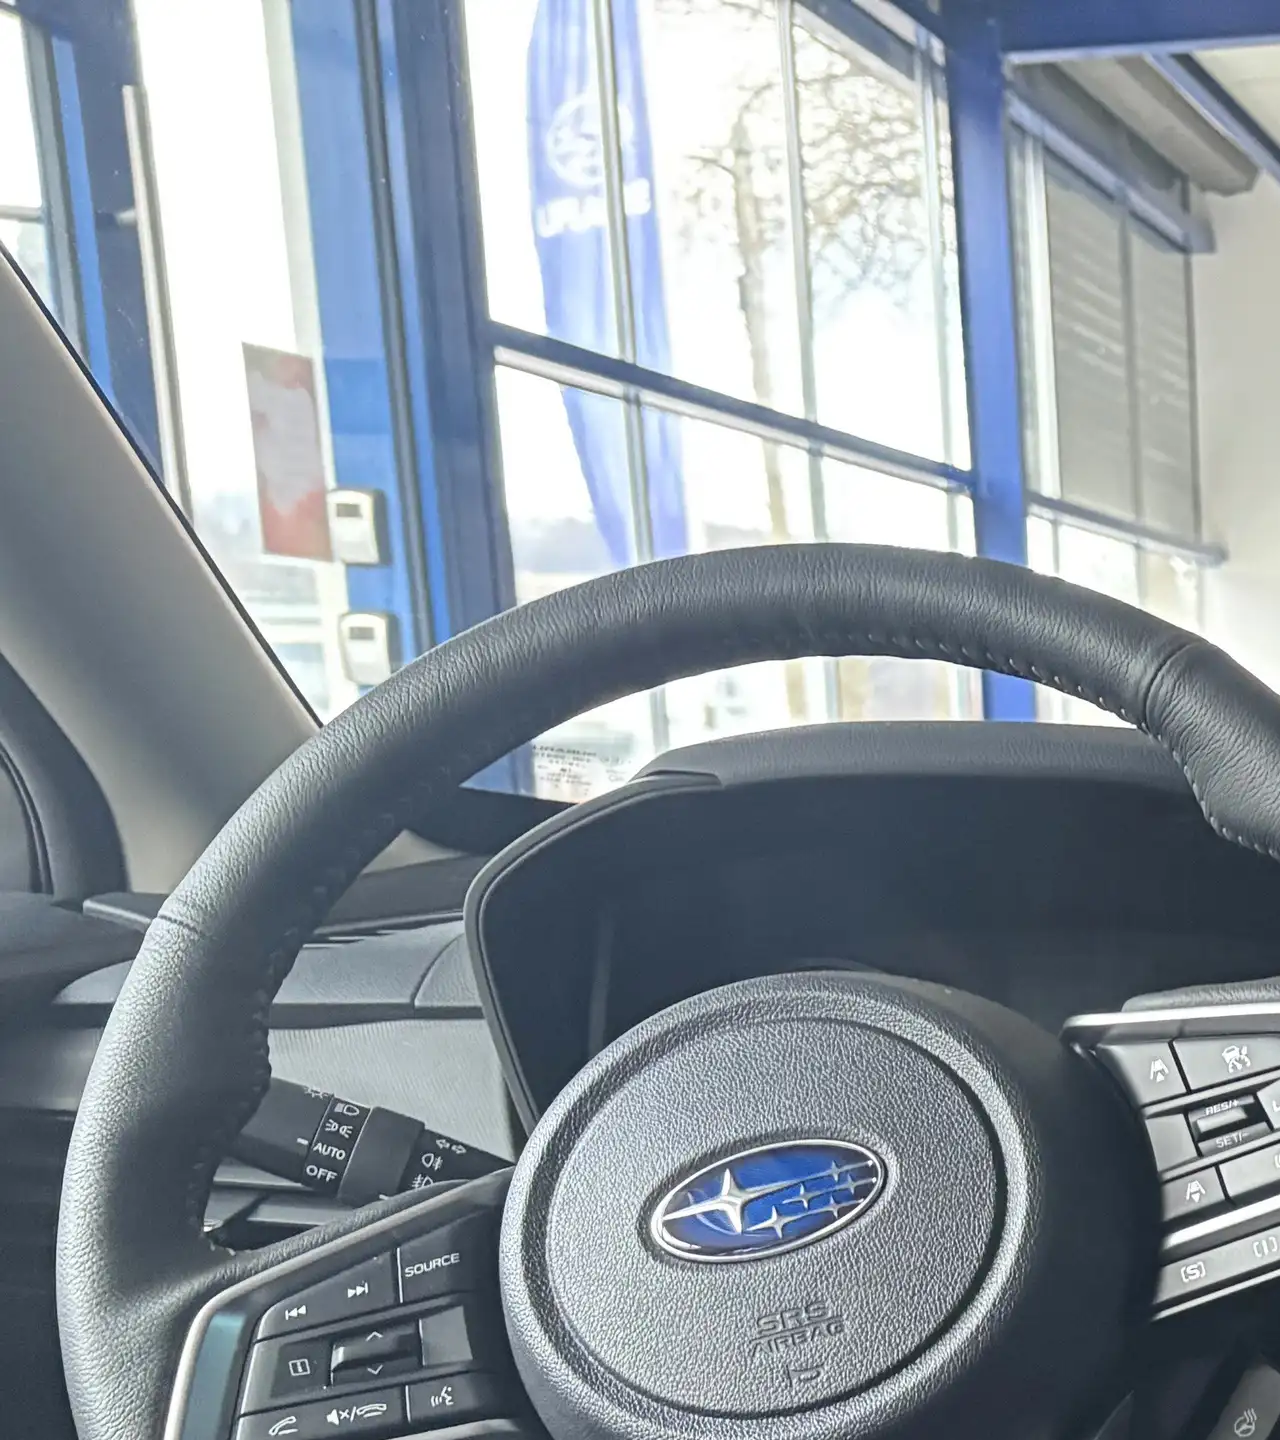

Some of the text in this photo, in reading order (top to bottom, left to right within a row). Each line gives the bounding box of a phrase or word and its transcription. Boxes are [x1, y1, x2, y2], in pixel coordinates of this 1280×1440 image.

[312, 1142, 346, 1160] AUTO
[306, 1164, 338, 1182] OFF
[404, 1252, 460, 1277] SOURCE
[756, 1300, 829, 1336] SRS
